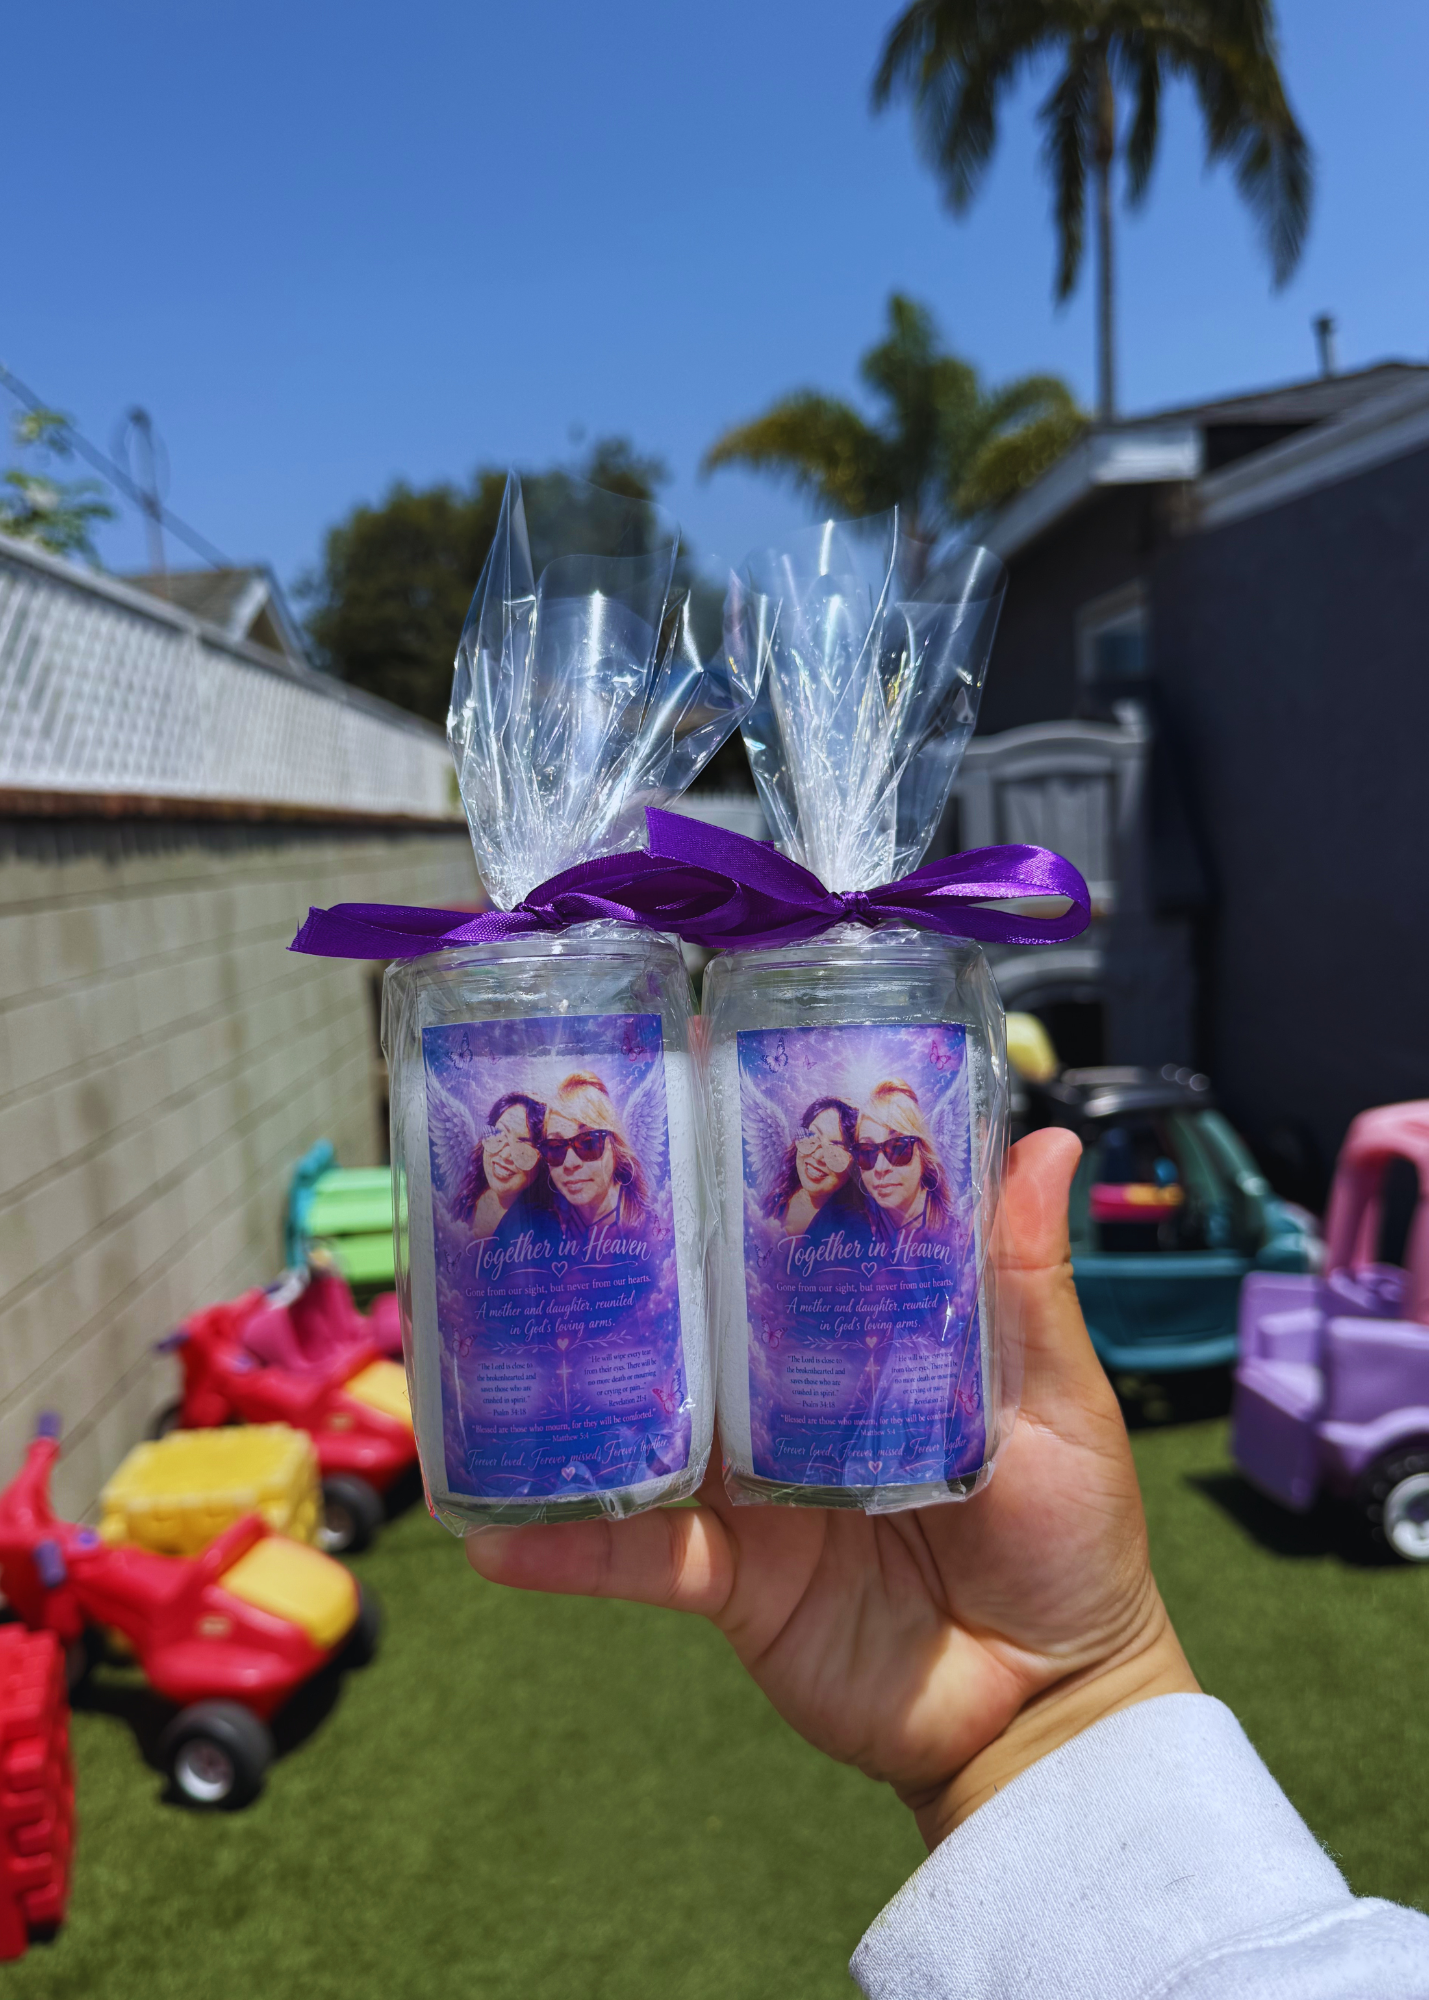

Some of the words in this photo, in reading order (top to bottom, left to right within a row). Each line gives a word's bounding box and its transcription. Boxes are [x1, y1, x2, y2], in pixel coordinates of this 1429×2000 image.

[466, 1230, 553, 1281] Together
[558, 1235, 580, 1256] in
[582, 1225, 652, 1262] Heaven
[777, 1230, 864, 1277] Together
[868, 1236, 888, 1258] in
[890, 1229, 954, 1265] Heaven
[465, 1288, 485, 1297] Gone
[487, 1285, 506, 1296] from
[508, 1286, 522, 1295] our
[524, 1284, 548, 1295] sight,
[550, 1283, 564, 1293] but
[567, 1282, 589, 1291] never
[592, 1279, 611, 1289] from
[613, 1278, 625, 1286] our
[628, 1274, 652, 1285] hearts.
[776, 1282, 796, 1292] Gone
[798, 1282, 816, 1292] from
[835, 1283, 857, 1294] sight,
[860, 1283, 873, 1292] but
[876, 1283, 897, 1292] never
[900, 1280, 917, 1290] from
[919, 1280, 930, 1289] our
[475, 1301, 487, 1320] A
[489, 1302, 521, 1317] mother
[524, 1300, 545, 1316] and
[595, 1290, 636, 1310] reunited
[785, 1296, 797, 1314] A
[800, 1298, 831, 1313] mother
[834, 1298, 855, 1313] and
[902, 1293, 940, 1310] reunited
[510, 1325, 521, 1335] in
[555, 1316, 585, 1337] loving
[589, 1318, 615, 1329] arms.
[819, 1321, 831, 1331] in
[864, 1316, 893, 1336] loving
[896, 1318, 921, 1328] arms.
[510, 1424, 527, 1432] those
[529, 1423, 543, 1432] who
[571, 1421, 581, 1429] for
[583, 1419, 597, 1429] they
[600, 1417, 612, 1425] will
[613, 1415, 621, 1423] be
[819, 1414, 836, 1425] those
[838, 1414, 851, 1425] who
[890, 1414, 904, 1426] they
[906, 1413, 917, 1422] will
[918, 1411, 925, 1421] be
[552, 1434, 577, 1442] Matthew
[580, 1432, 589, 1440] 5:4
[468, 1449, 497, 1470] Forever
[528, 1447, 565, 1471] Forever
[602, 1439, 636, 1464] Forever
